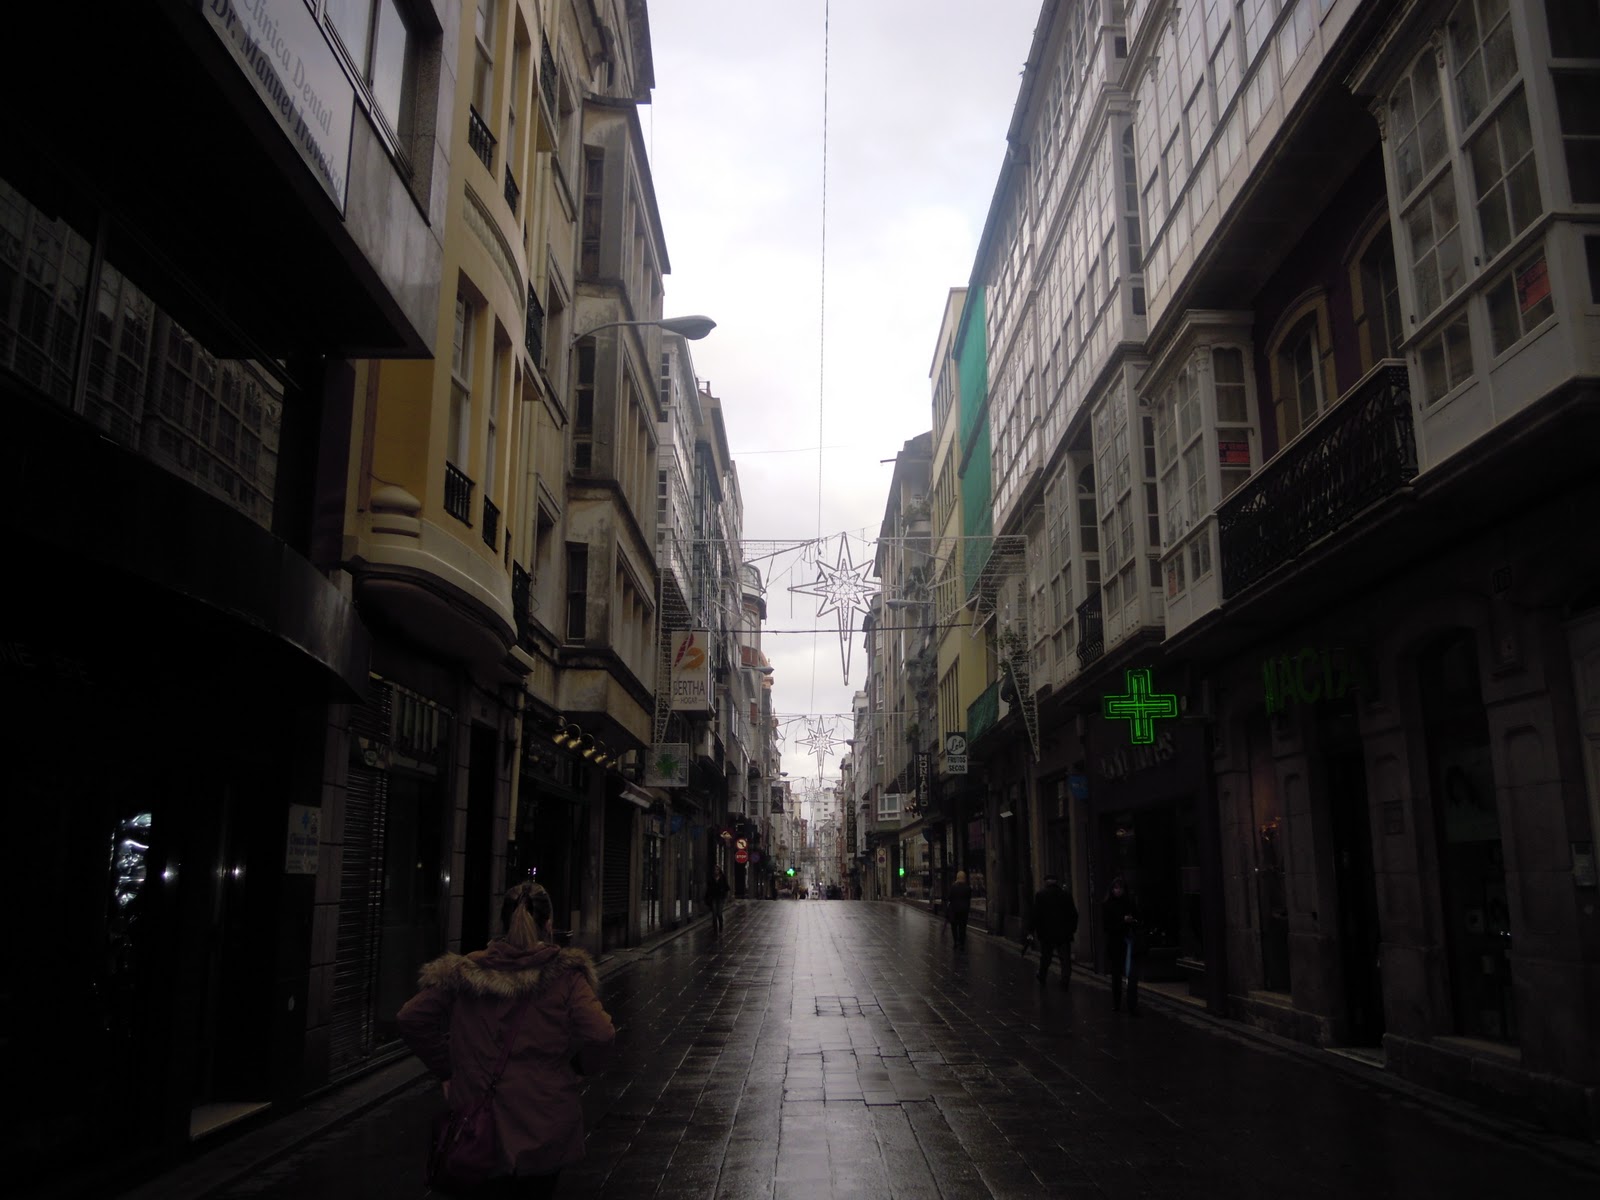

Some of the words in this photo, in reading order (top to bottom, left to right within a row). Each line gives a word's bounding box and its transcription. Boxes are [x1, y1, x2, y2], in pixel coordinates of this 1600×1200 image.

[210, 0, 236, 39] Dr.
[240, 26, 295, 123] Manuel
[293, 55, 333, 136] Dental
[673, 680, 705, 695] BERTHA
